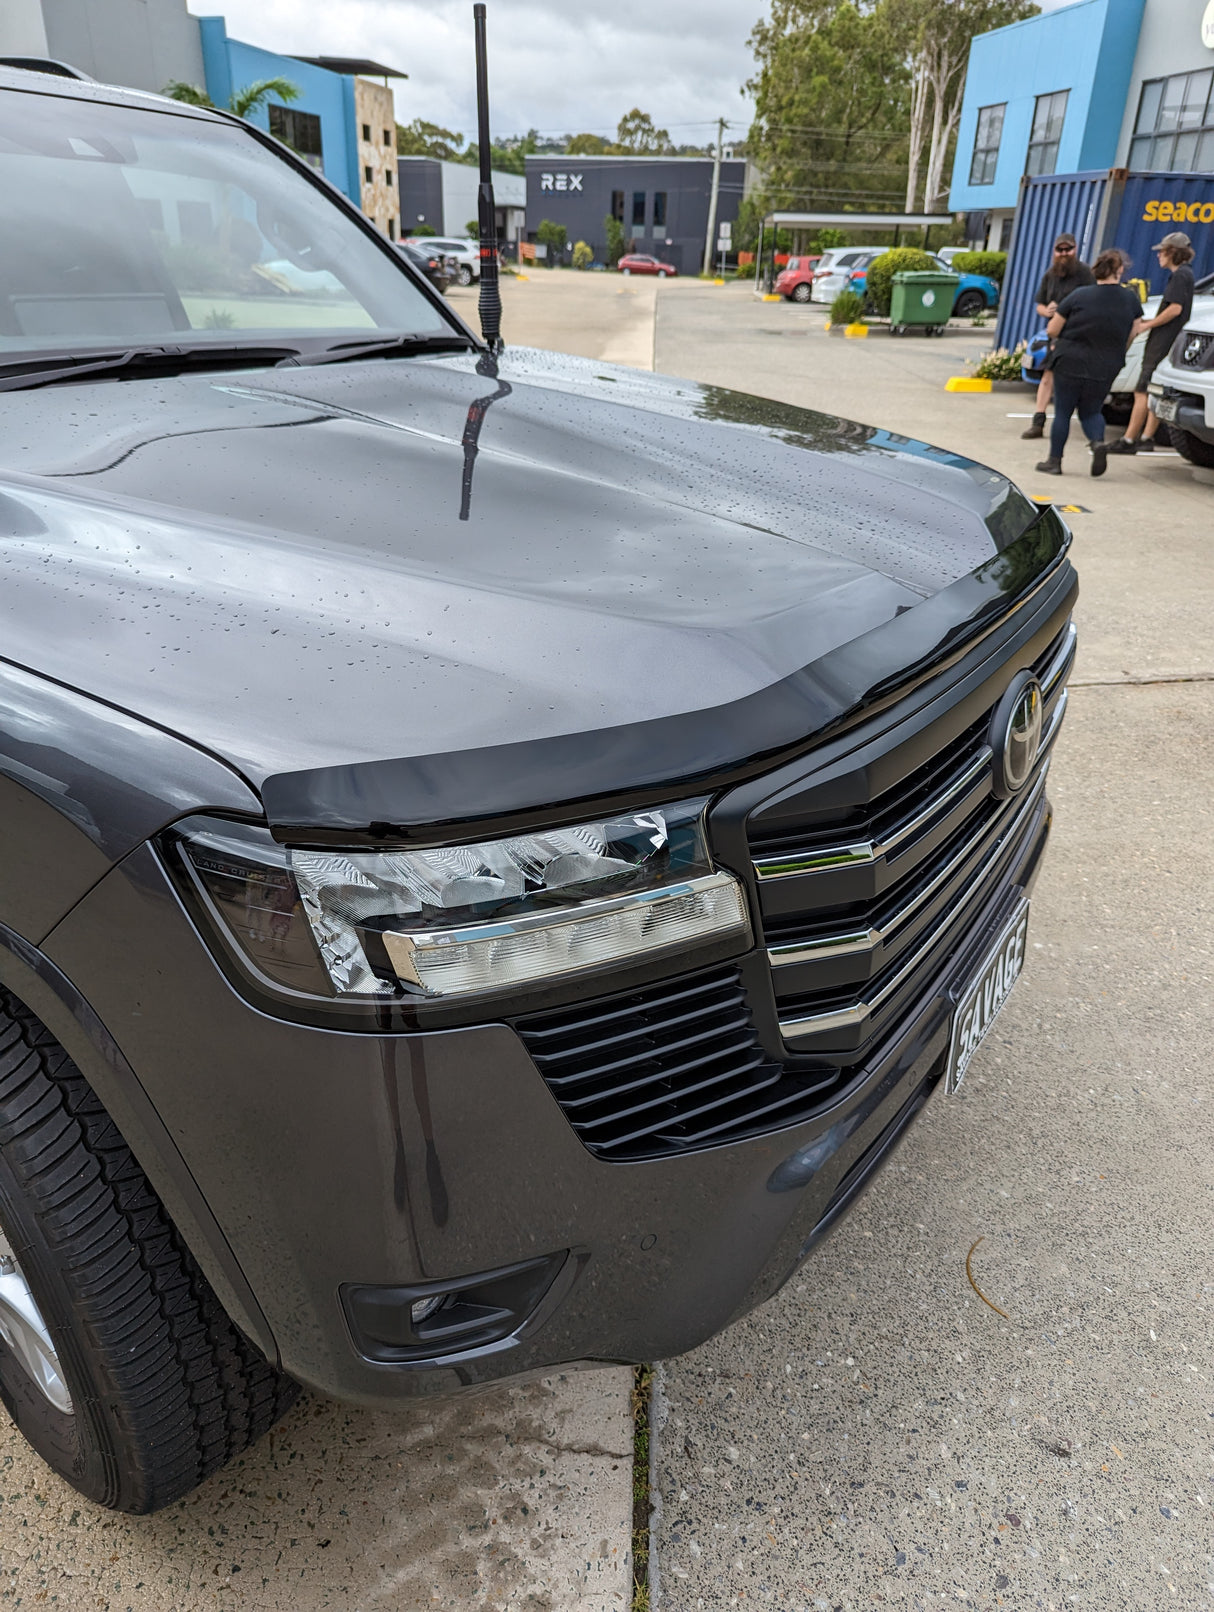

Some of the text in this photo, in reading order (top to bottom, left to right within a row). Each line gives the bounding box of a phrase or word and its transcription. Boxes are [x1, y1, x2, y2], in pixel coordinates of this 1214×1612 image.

[541, 173, 583, 190] REX
[1142, 200, 1214, 223] seaco
[197, 858, 225, 871] LAND
